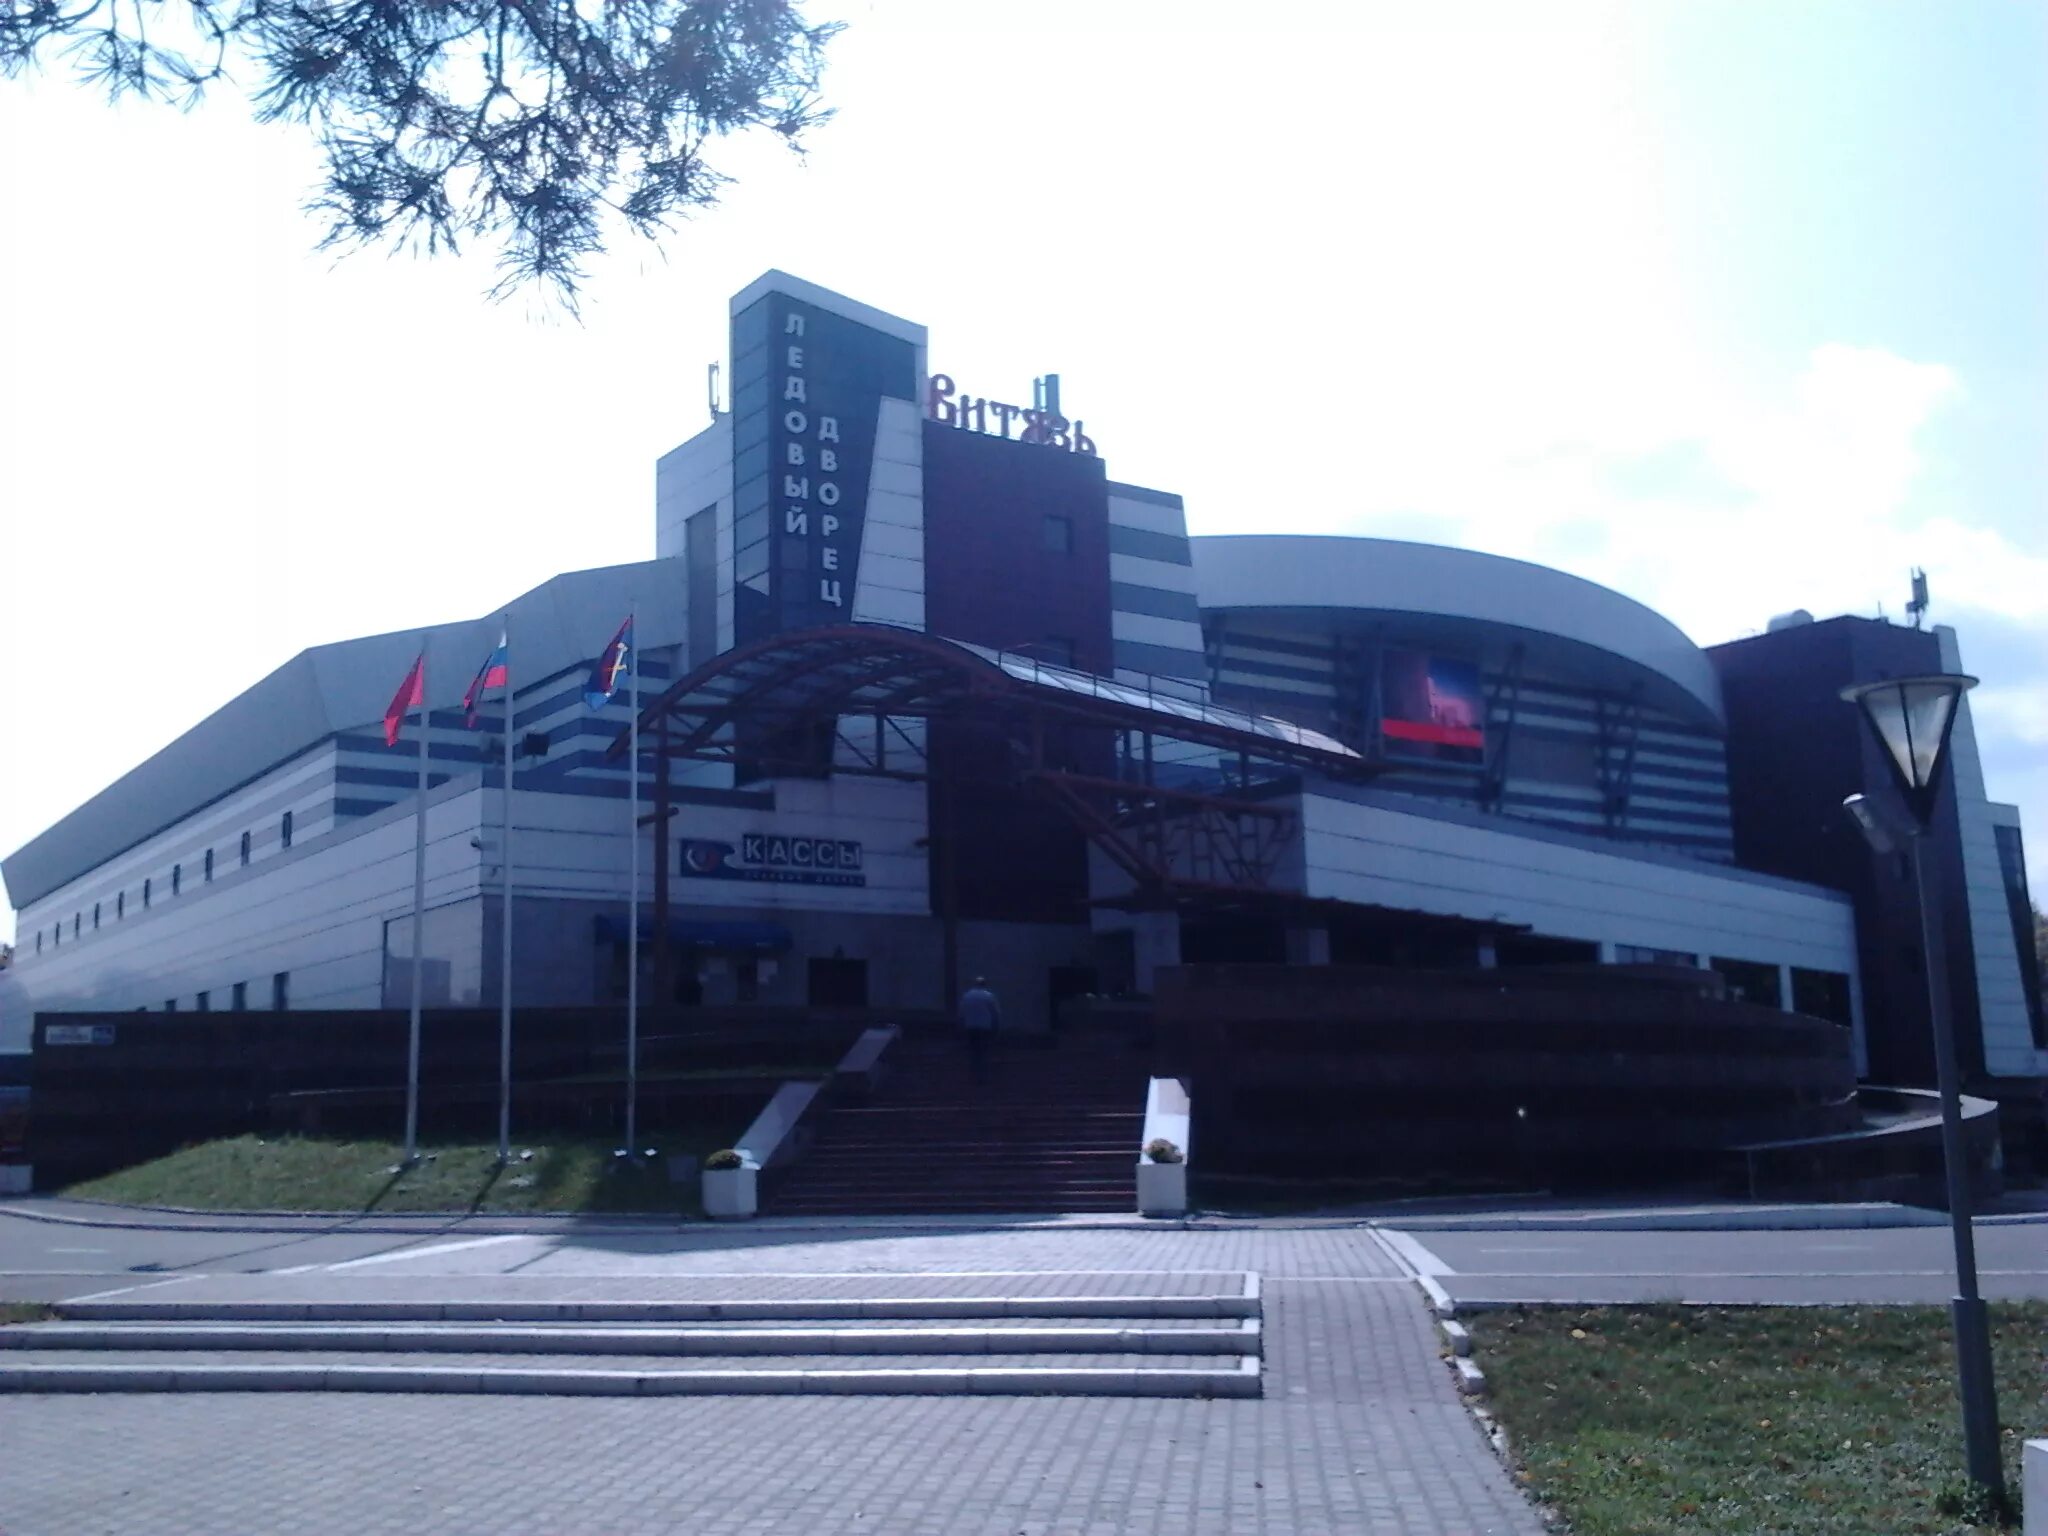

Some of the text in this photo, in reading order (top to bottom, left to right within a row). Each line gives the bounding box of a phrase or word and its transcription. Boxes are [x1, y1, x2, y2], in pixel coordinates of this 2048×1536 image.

[784, 313, 809, 536] ЛЕДОВЫЙ
[818, 416, 842, 607] ДВОРЕЦ
[745, 838, 860, 866] КАССЫ
